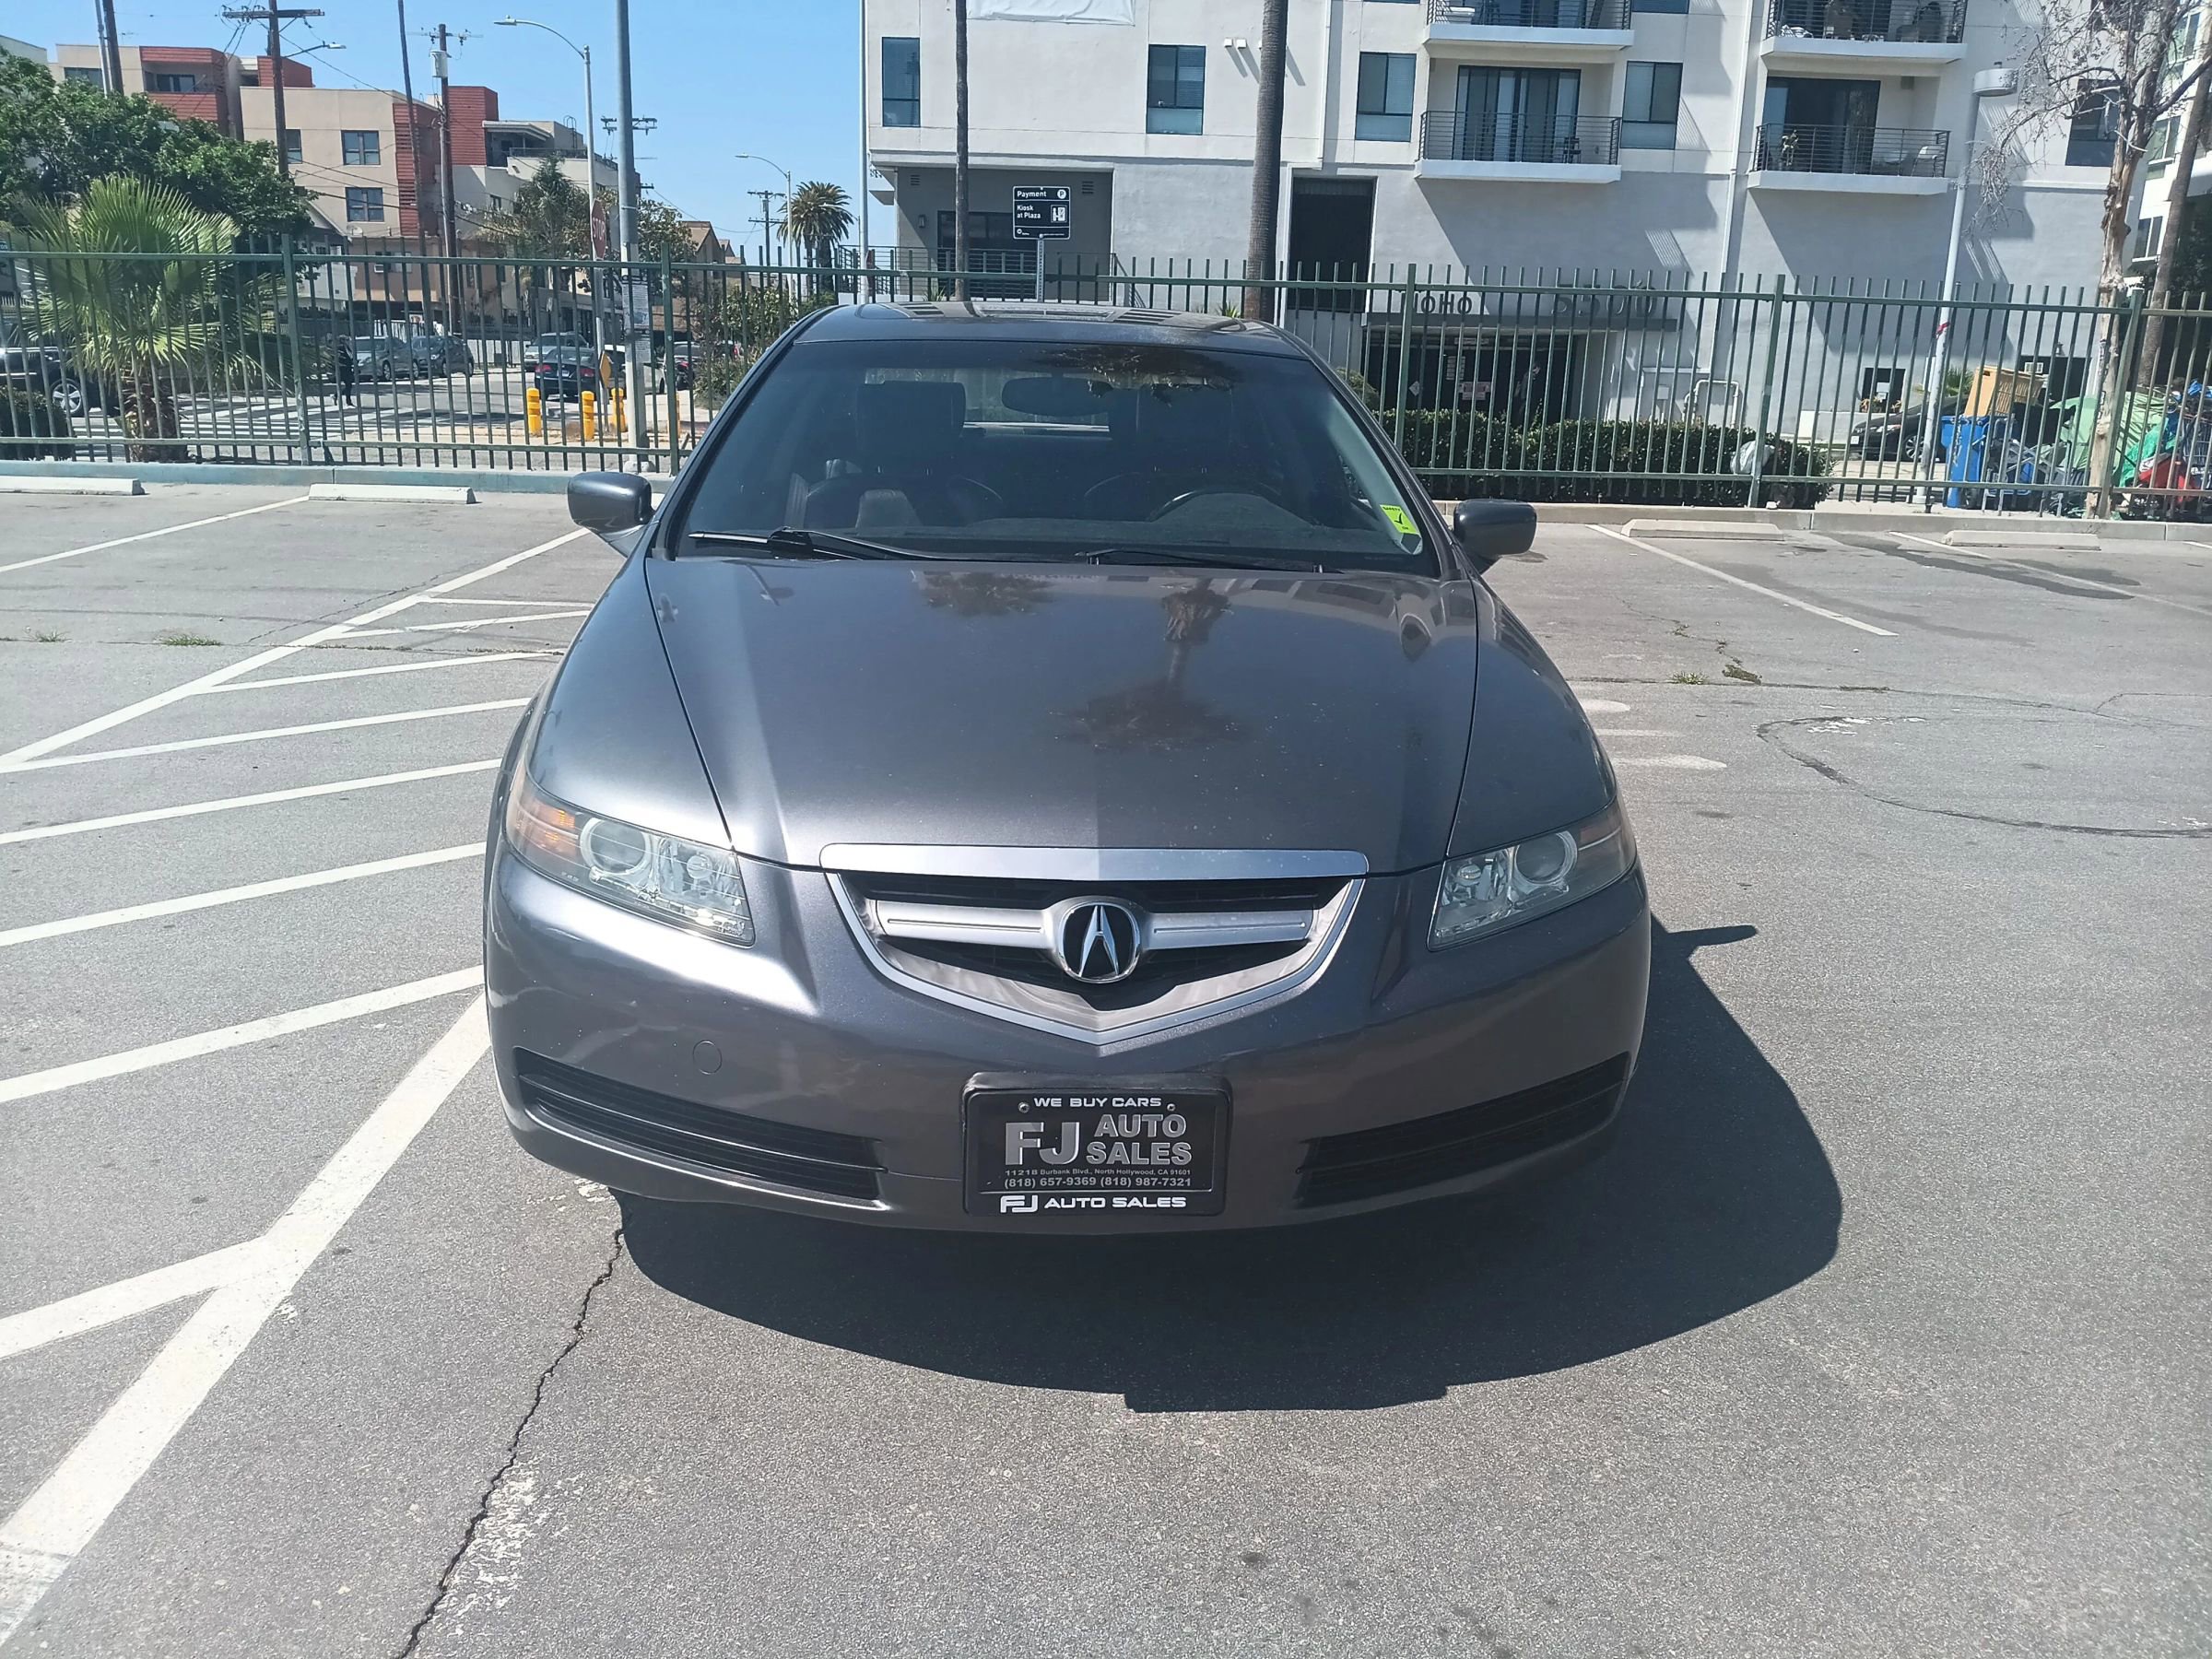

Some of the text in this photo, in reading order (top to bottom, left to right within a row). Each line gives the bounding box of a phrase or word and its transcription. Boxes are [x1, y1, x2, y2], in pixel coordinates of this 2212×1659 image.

[593, 217, 606, 241] STOP
[1033, 1098, 1162, 1107] WE BUY CARS
[1094, 1113, 1187, 1138] AUTO
[1005, 1122, 1080, 1165] FJ
[1086, 1141, 1193, 1166] SALES
[1005, 1176, 1191, 1189] (818) 657-9369 (818) 987-7321
[1000, 1194, 1187, 1213] FJ AUTO SALES
